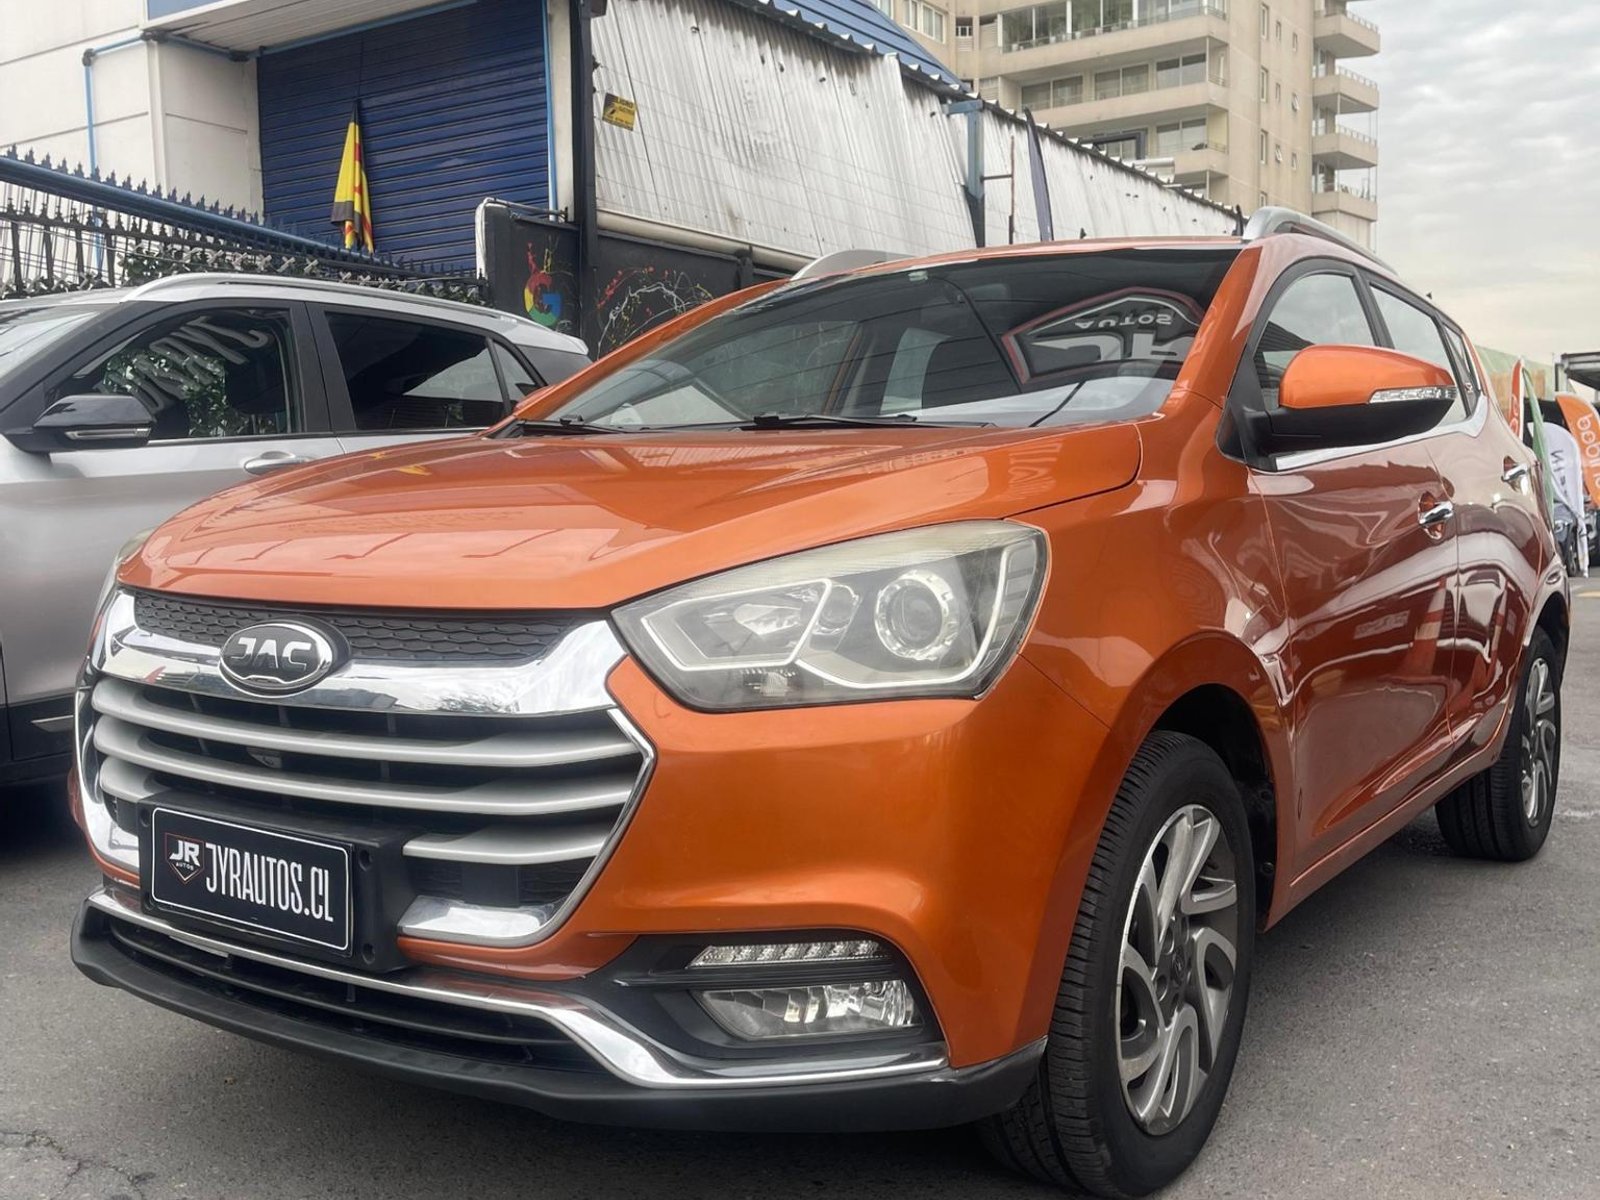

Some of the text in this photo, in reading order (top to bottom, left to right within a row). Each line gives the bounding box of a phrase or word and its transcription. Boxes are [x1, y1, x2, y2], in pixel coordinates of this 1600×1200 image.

[231, 636, 312, 671] JAC
[169, 840, 201, 867] JR
[205, 842, 334, 922] JYRAUTOS.CL
